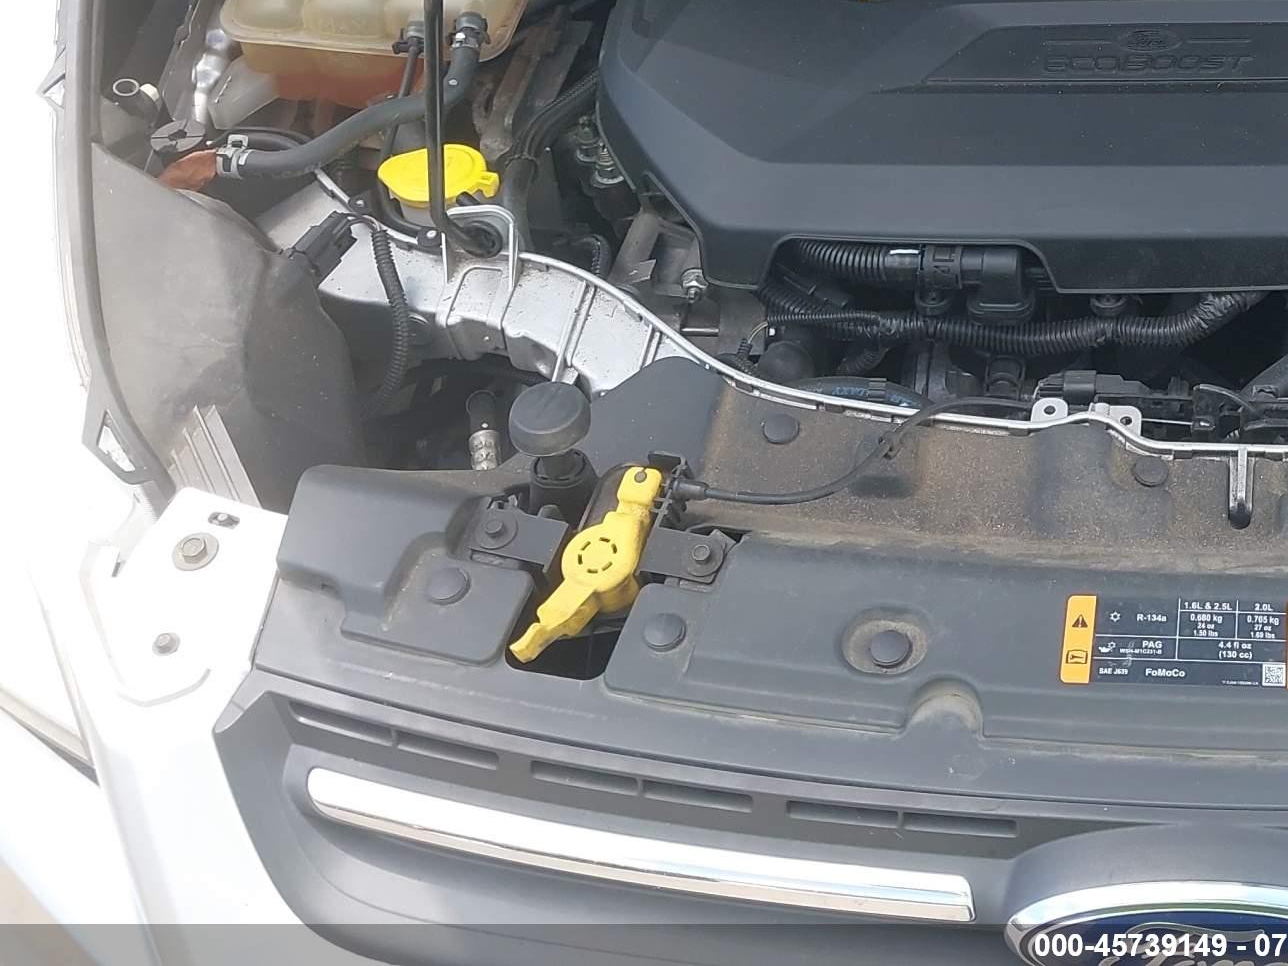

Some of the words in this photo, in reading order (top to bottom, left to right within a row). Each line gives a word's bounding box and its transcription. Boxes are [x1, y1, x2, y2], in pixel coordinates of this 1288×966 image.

[1183, 601, 1203, 610] 1.6L
[1204, 602, 1212, 610] &
[1213, 602, 1233, 611] 2.5L
[1254, 603, 1274, 611] 2.0L
[1136, 614, 1167, 622] R-134a
[1190, 614, 1211, 622] 0.680
[1212, 614, 1223, 624] kg
[1269, 615, 1280, 626] kg
[1264, 631, 1276, 639] lbs
[1142, 640, 1163, 649] PAG
[1218, 641, 1232, 649] 4.4
[1233, 641, 1240, 649] fl
[1218, 650, 1238, 659] (130
[1238, 651, 1253, 660] cc)
[1098, 667, 1112, 675] SAE
[1145, 668, 1186, 677] FoMoCo
